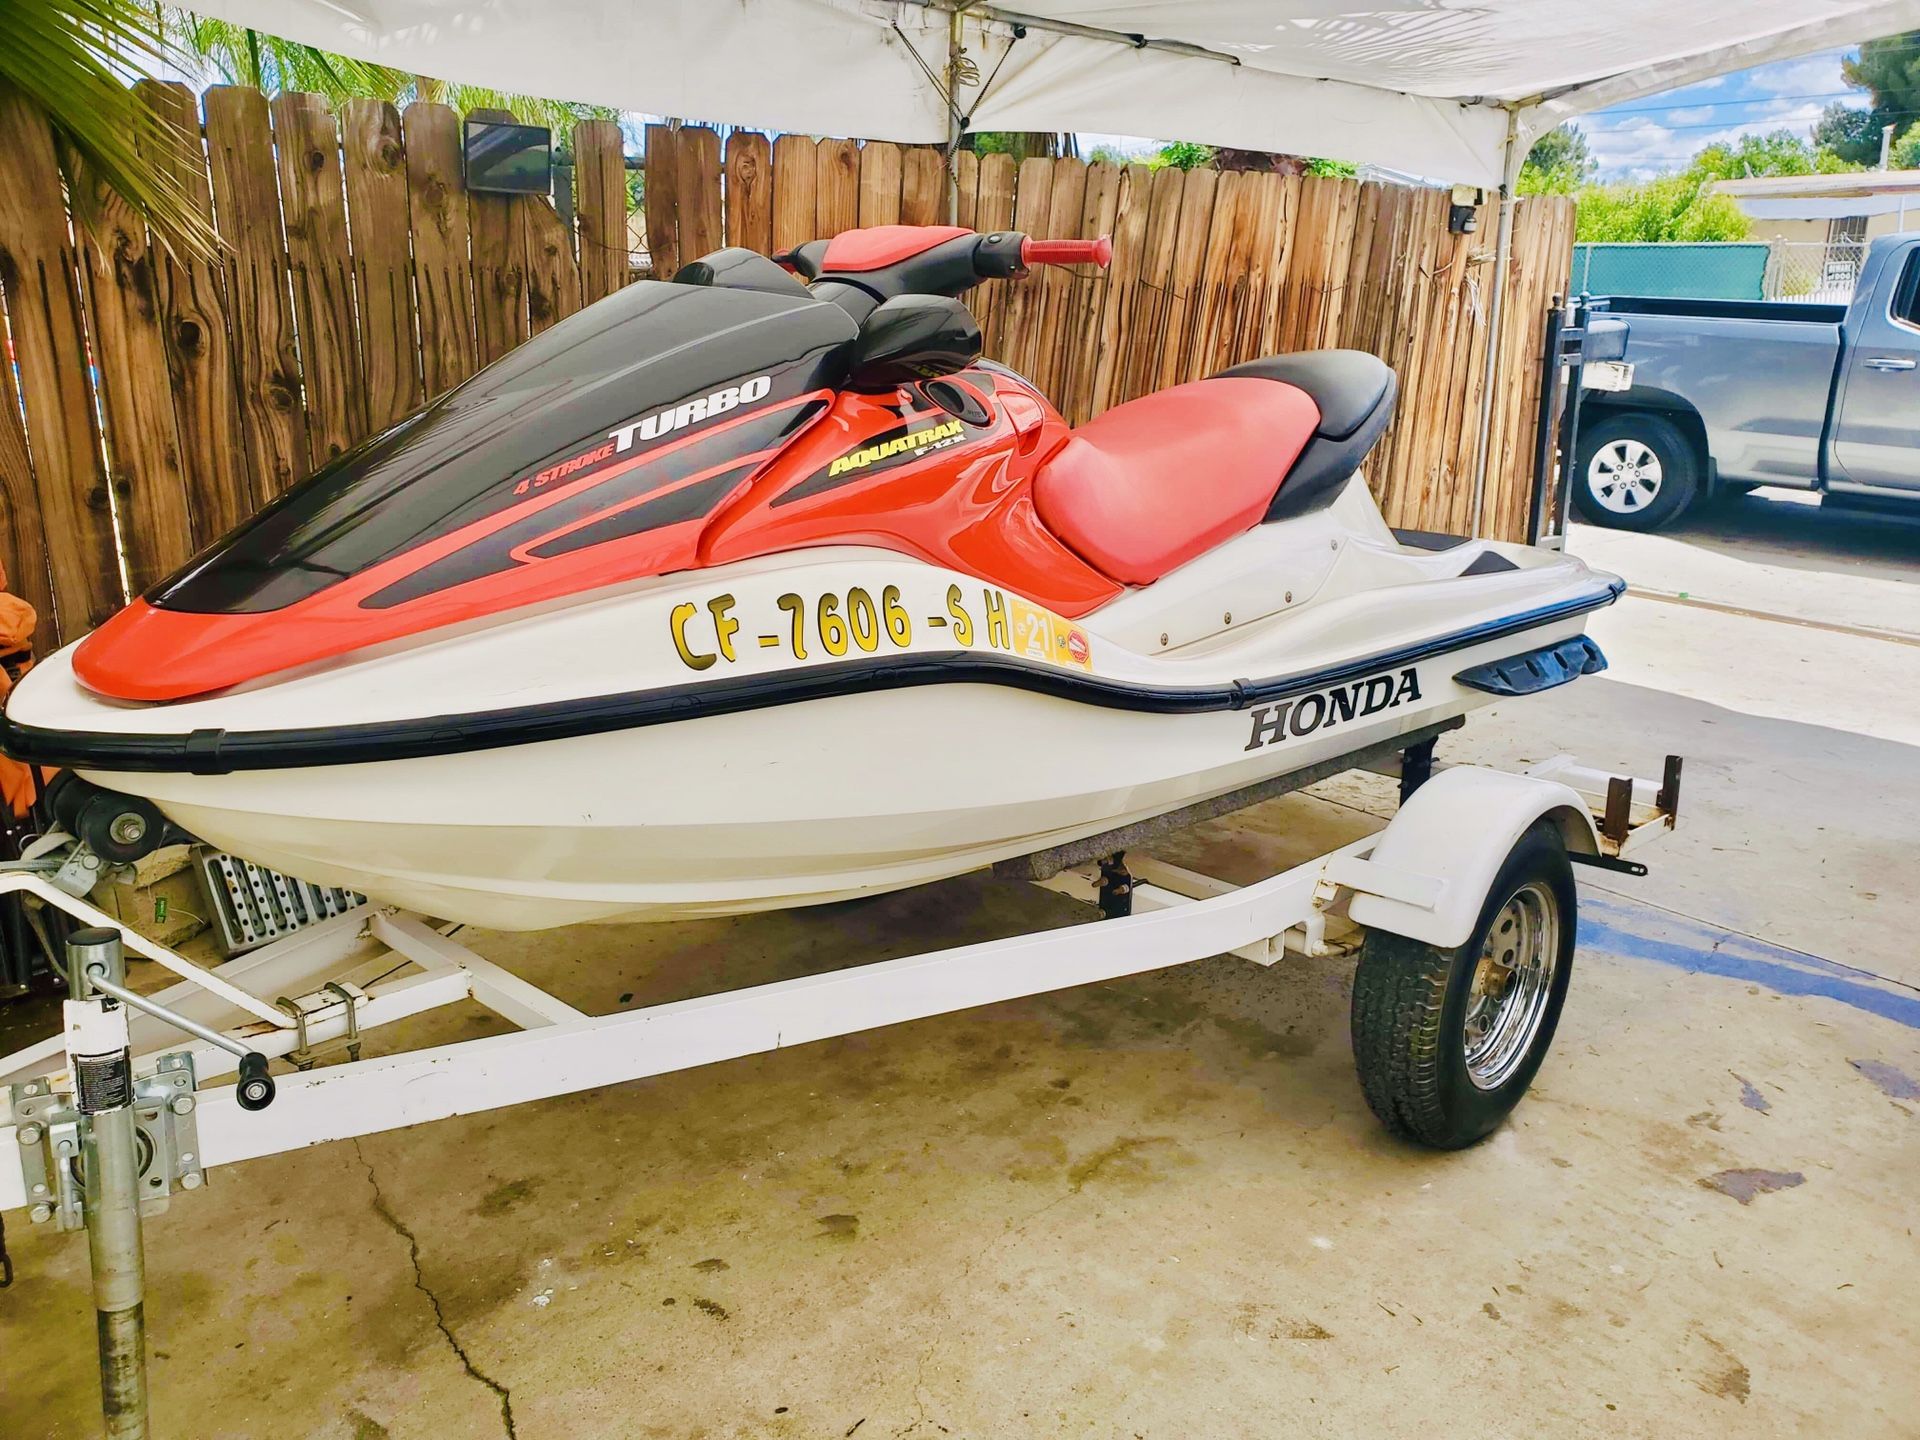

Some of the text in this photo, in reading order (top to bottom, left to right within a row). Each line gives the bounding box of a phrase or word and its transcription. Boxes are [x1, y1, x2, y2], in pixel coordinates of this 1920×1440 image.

[1835, 272, 1851, 280] DOG
[512, 376, 771, 495] 4 STROKE TURBO
[828, 420, 965, 477] AQUATRAX
[913, 433, 967, 456] F-12X
[1026, 613, 1049, 651] 21
[1244, 667, 1422, 751] HONDA
